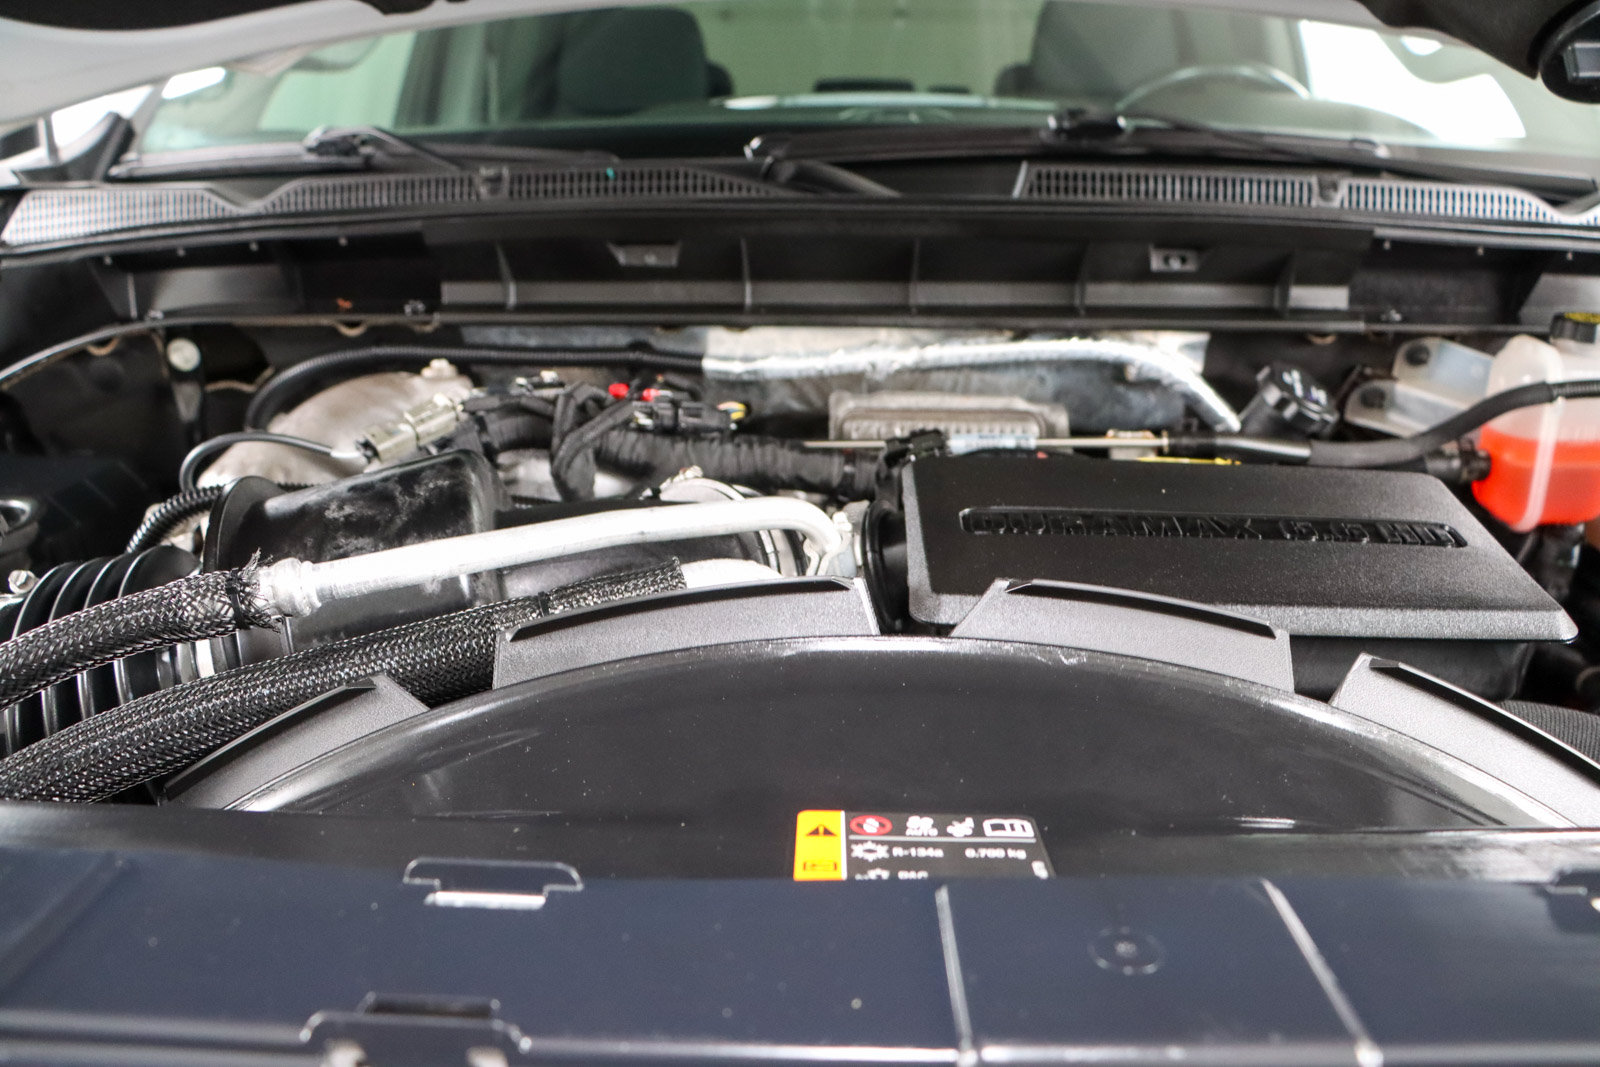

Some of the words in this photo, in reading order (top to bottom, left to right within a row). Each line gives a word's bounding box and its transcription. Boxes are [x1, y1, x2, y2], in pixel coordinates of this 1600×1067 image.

[970, 511, 1262, 541] DURAMAX
[905, 827, 939, 837] AUTO
[892, 846, 944, 858] R-134a
[1007, 847, 1027, 860] kg
